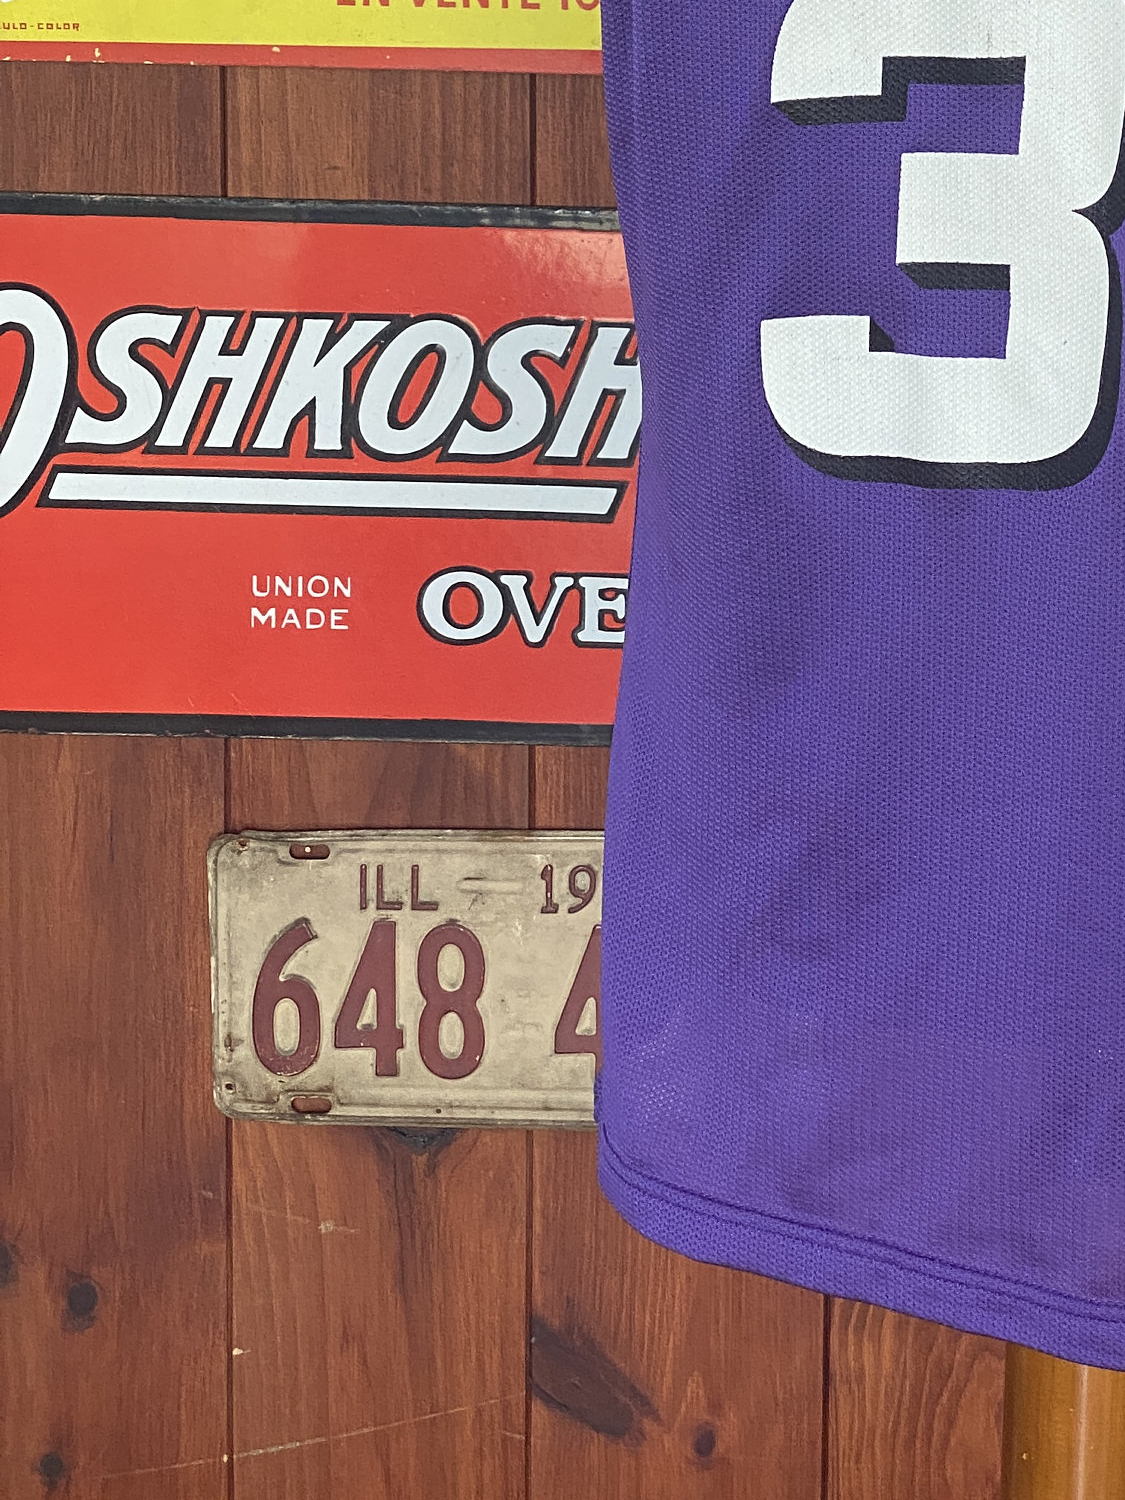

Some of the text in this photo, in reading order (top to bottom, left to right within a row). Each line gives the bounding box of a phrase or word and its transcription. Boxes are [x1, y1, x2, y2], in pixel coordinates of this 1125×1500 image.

[251, 575, 351, 598] UNION
[418, 567, 630, 647] OVE
[251, 608, 349, 630] MADE
[360, 864, 597, 914] ILL 19
[252, 917, 486, 1080] 648
